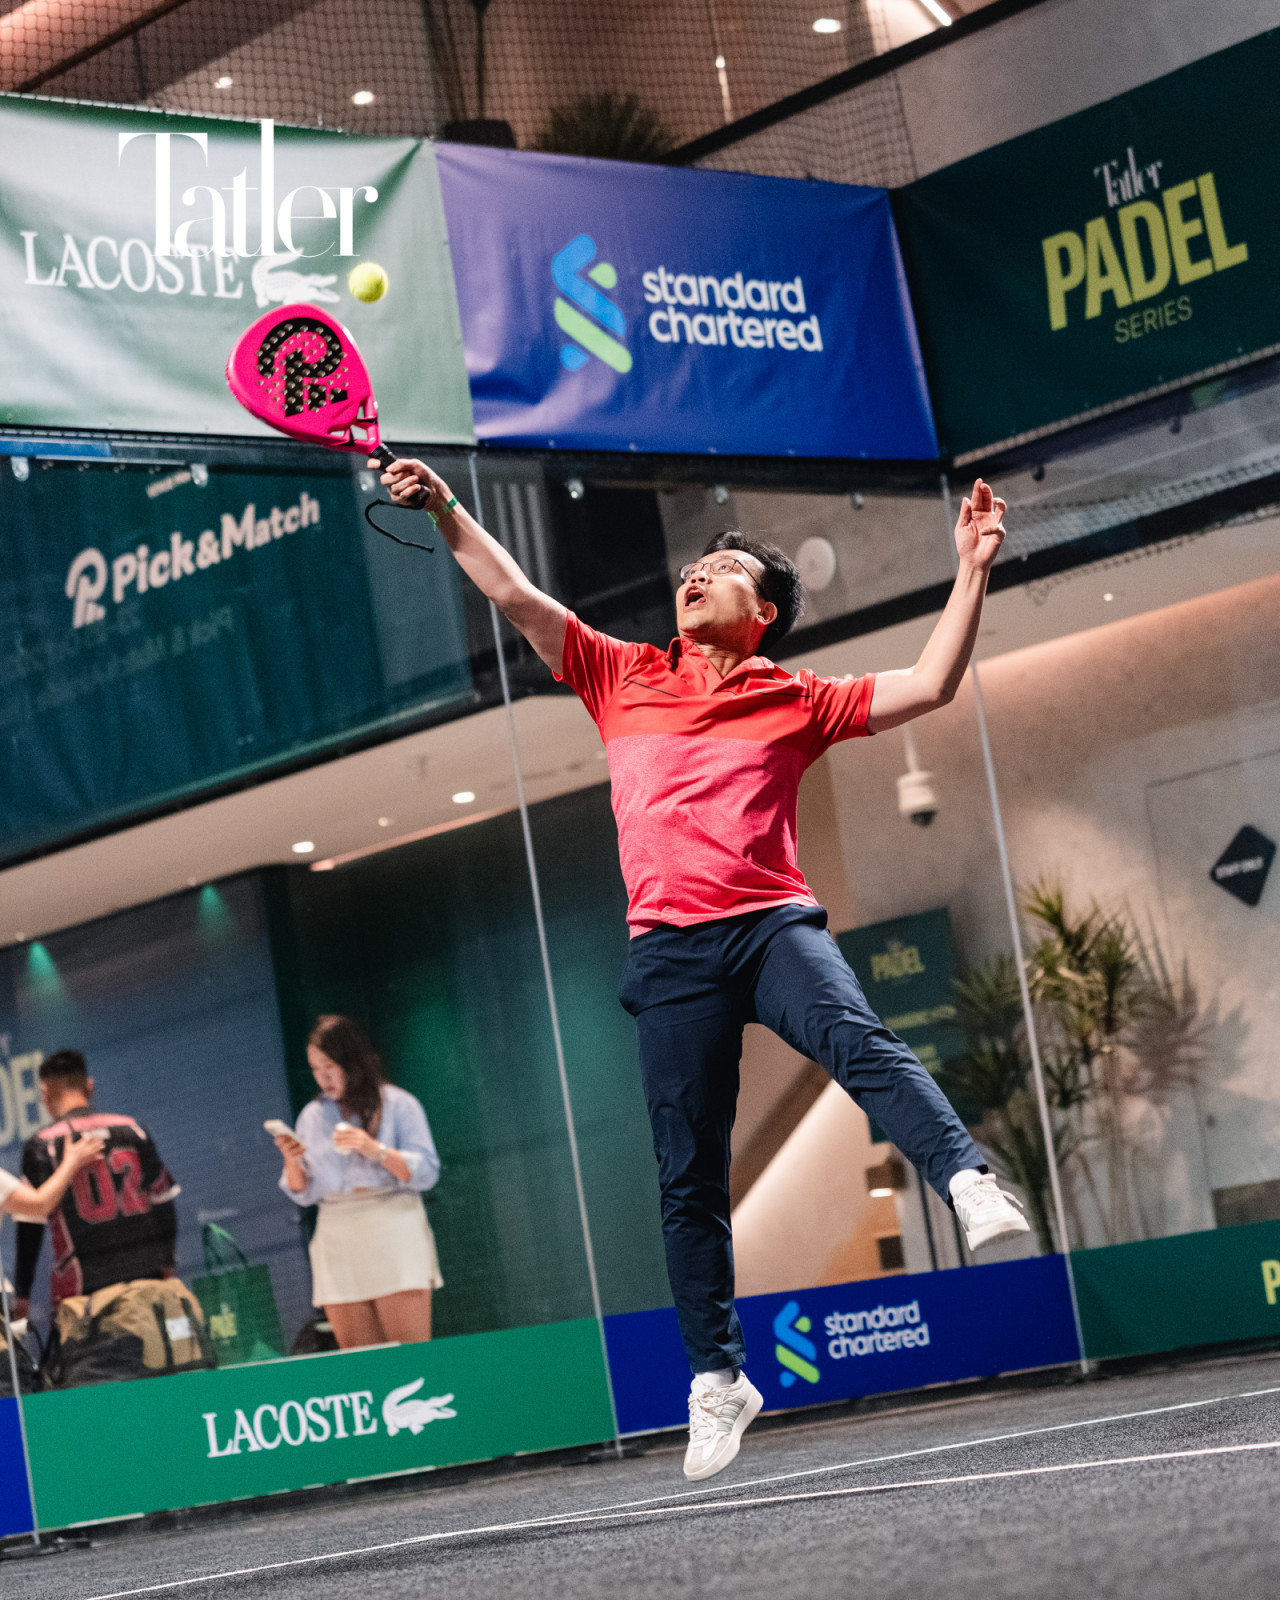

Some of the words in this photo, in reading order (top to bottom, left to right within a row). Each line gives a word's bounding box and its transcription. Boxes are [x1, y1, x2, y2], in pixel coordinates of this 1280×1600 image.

[20, 230, 244, 299] LACOSTE
[1041, 171, 1249, 332] PADEL
[642, 265, 806, 314] standard
[649, 304, 823, 352] chartered
[1114, 295, 1193, 344] SERIES
[112, 491, 321, 604] Pick&Match
[71, 1147, 150, 1225] 02
[824, 1300, 921, 1336] standard
[828, 1322, 931, 1360] chartered
[201, 1389, 378, 1458] LACOSTE
